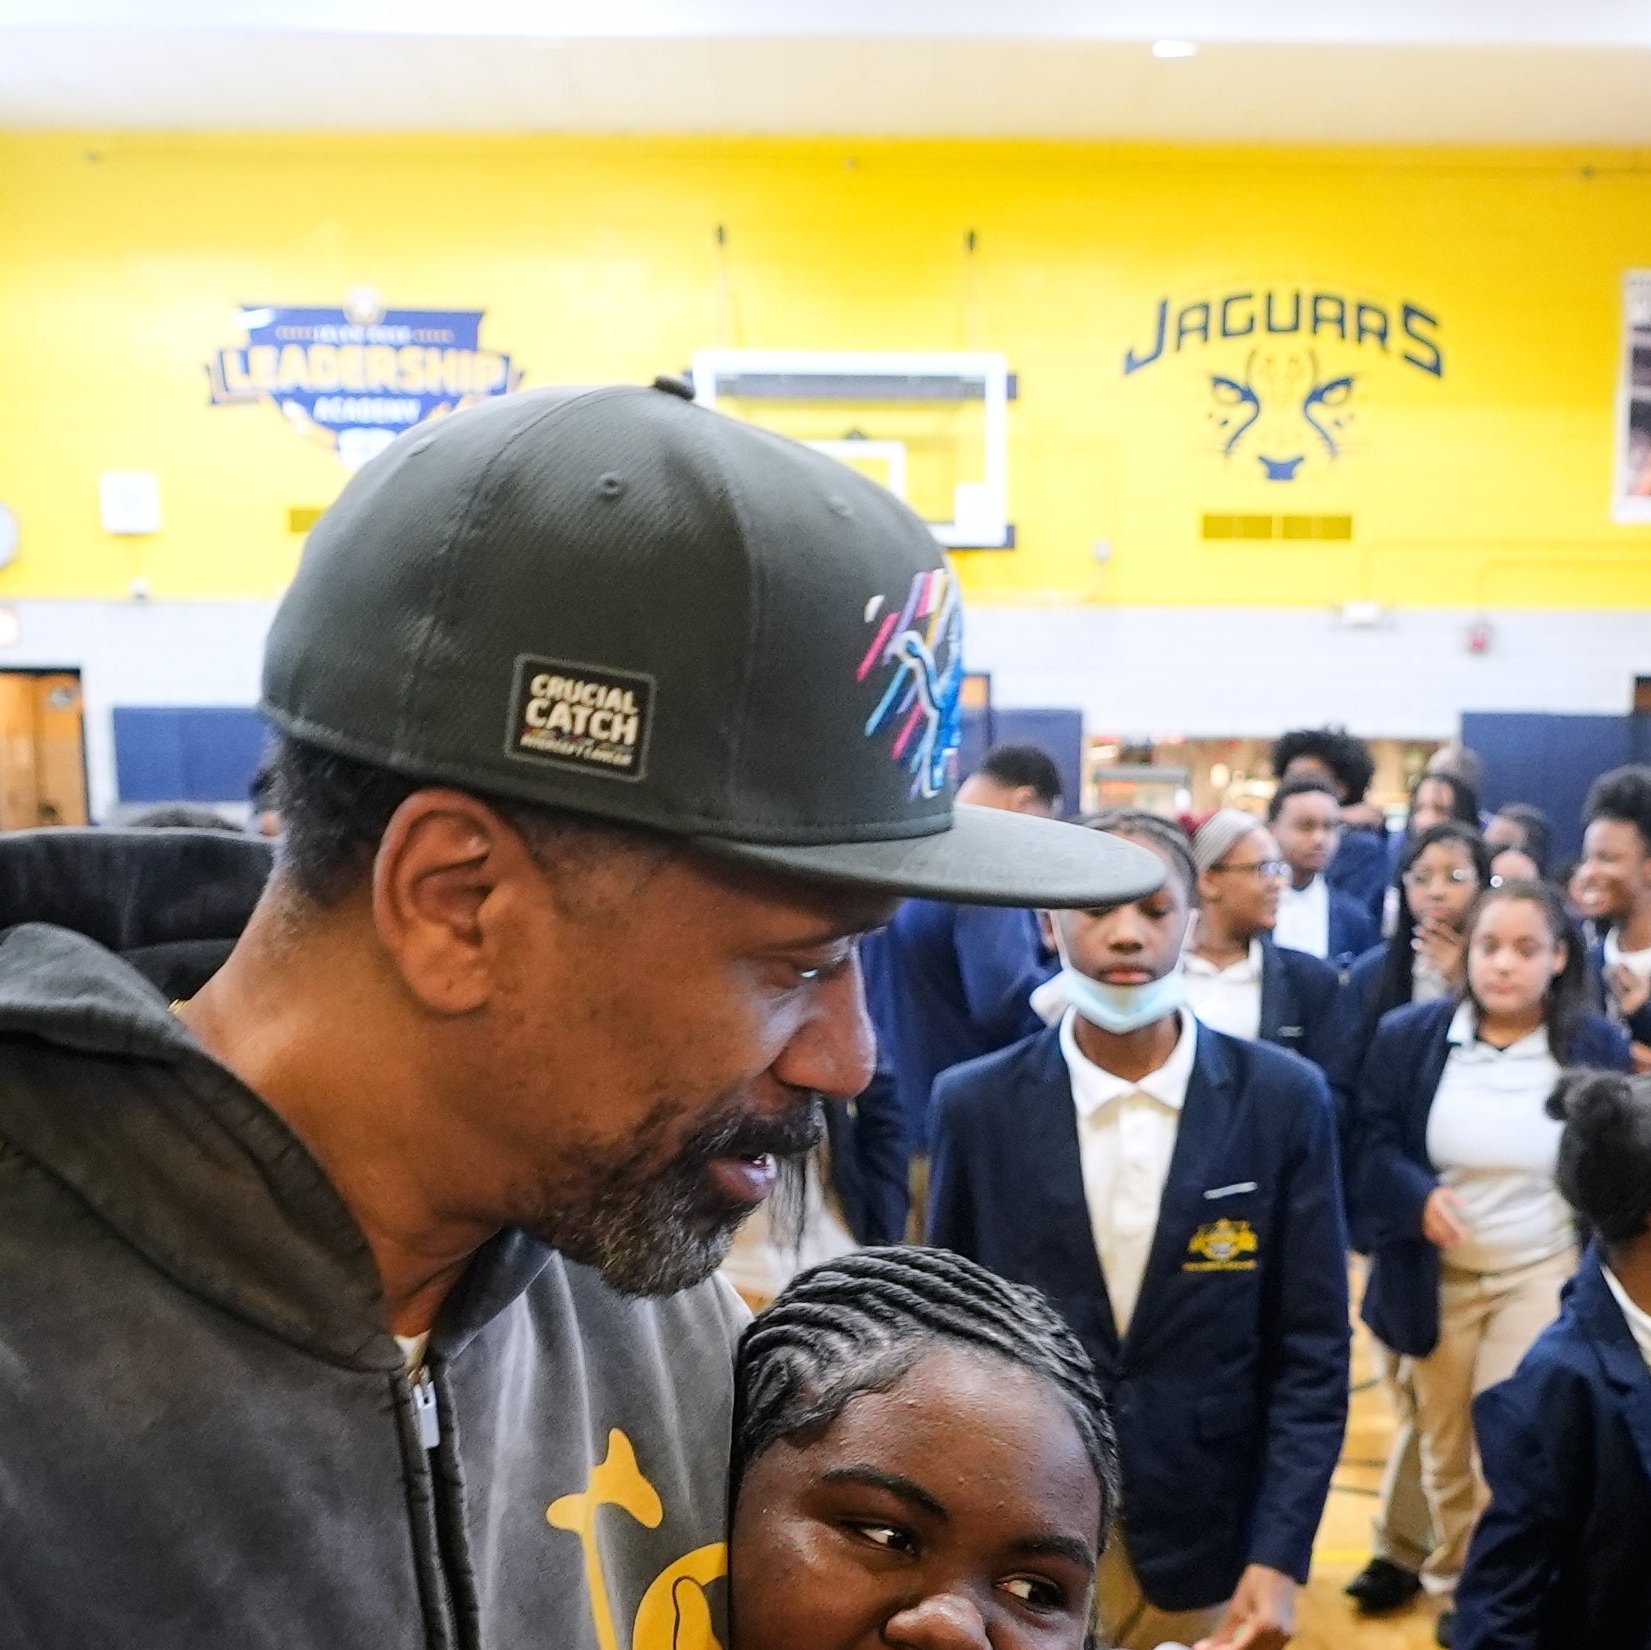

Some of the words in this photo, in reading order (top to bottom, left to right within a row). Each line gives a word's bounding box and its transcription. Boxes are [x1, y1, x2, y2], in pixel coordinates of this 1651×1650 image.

[1123, 290, 1443, 378] JAGUARS
[222, 343, 508, 396] LEADERSHIP
[530, 673, 640, 715] CRUCIAL
[524, 697, 641, 746] CATCH
